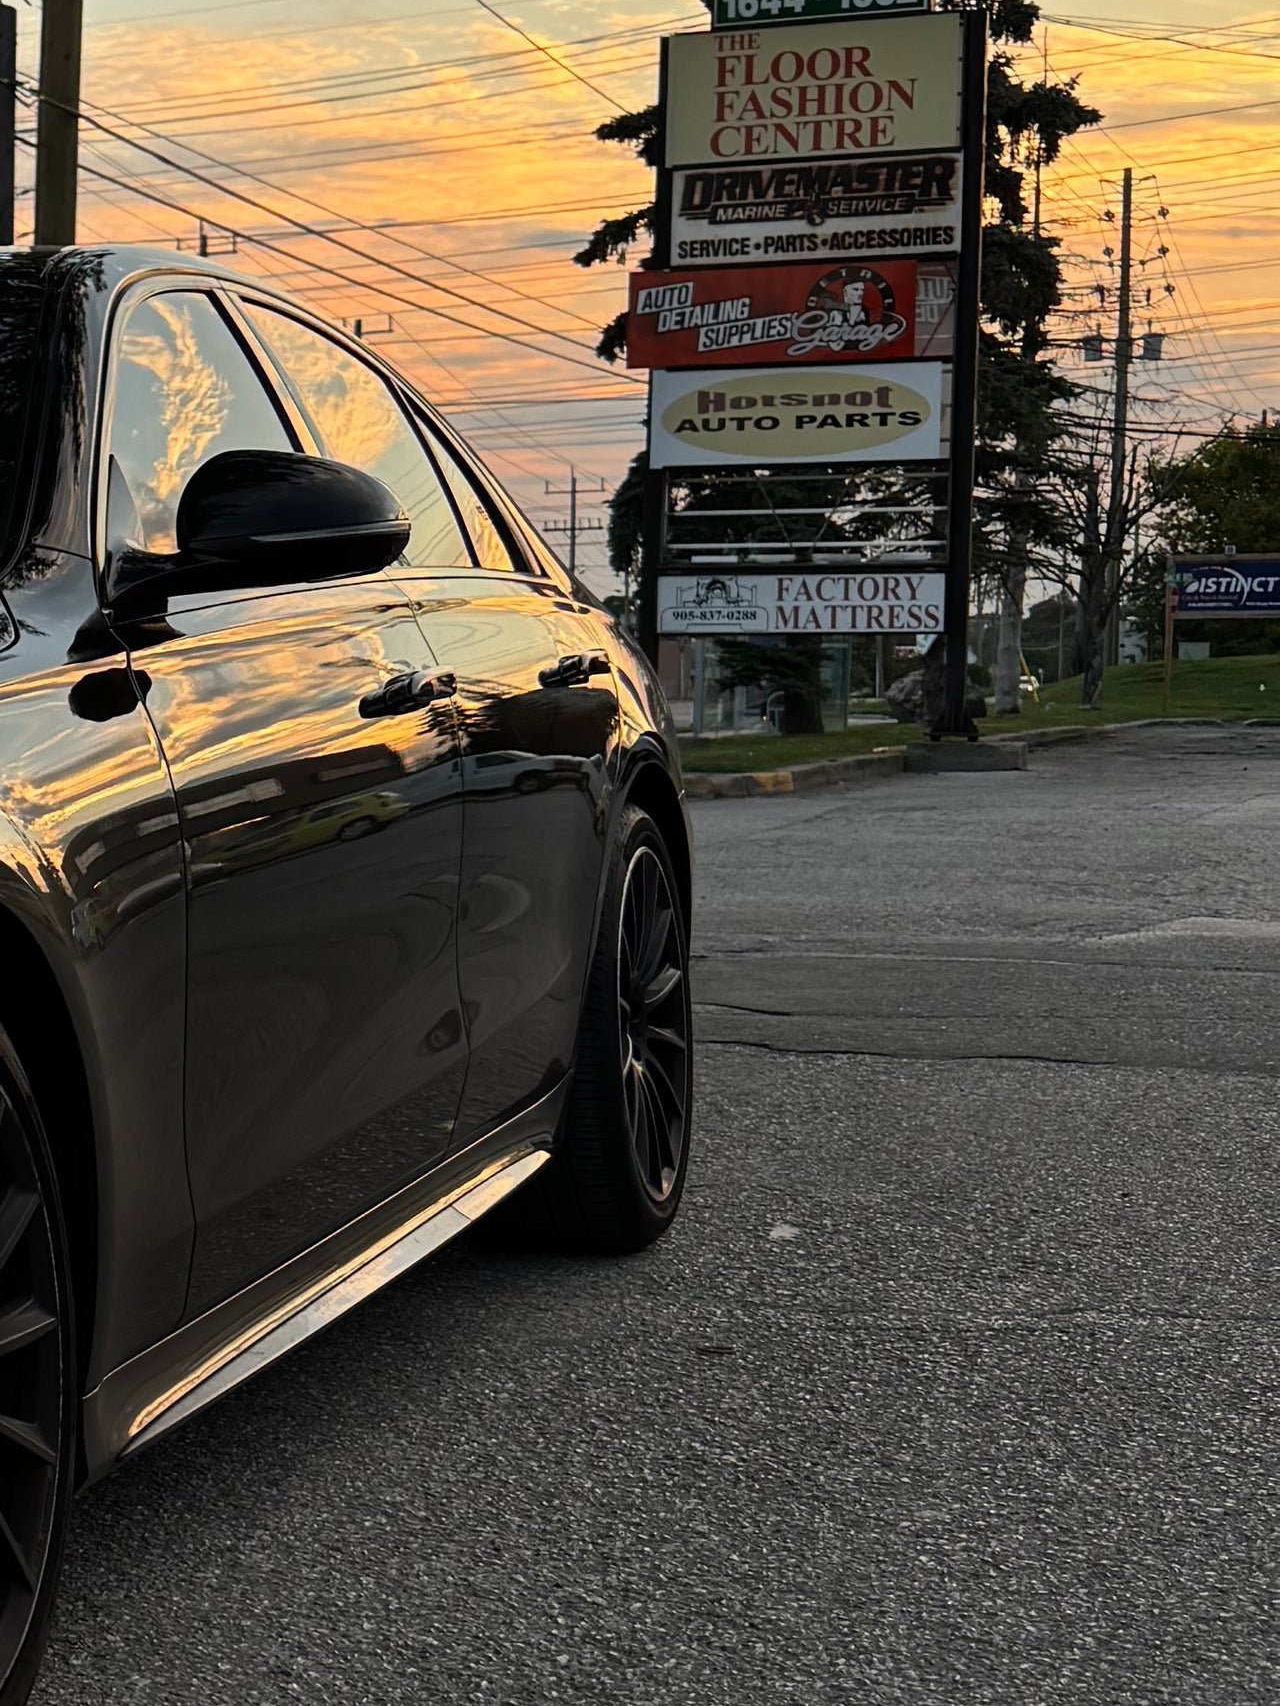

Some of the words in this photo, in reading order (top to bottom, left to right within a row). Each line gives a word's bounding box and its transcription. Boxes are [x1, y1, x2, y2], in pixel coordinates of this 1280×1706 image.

[714, 33, 760, 52] THE
[714, 46, 874, 89] FLOOR
[713, 78, 919, 123] FASHION
[710, 115, 895, 158] CENTRE
[680, 158, 955, 212] DRIVEMASTER
[716, 204, 787, 221] MARINE
[827, 197, 908, 215] SERVICE
[677, 237, 751, 260] SERVICE
[829, 225, 954, 251] ACCESSORIES
[641, 284, 690, 311] AUTO
[657, 297, 751, 333] DETAILING
[702, 316, 791, 349] SUPPLIES
[786, 310, 906, 357] Garage
[673, 415, 780, 434] AUTO
[795, 411, 922, 430] PARTS
[776, 576, 925, 602] FACTORY
[672, 610, 757, 621] 905-837-0288
[775, 604, 940, 630] MATTRESS
